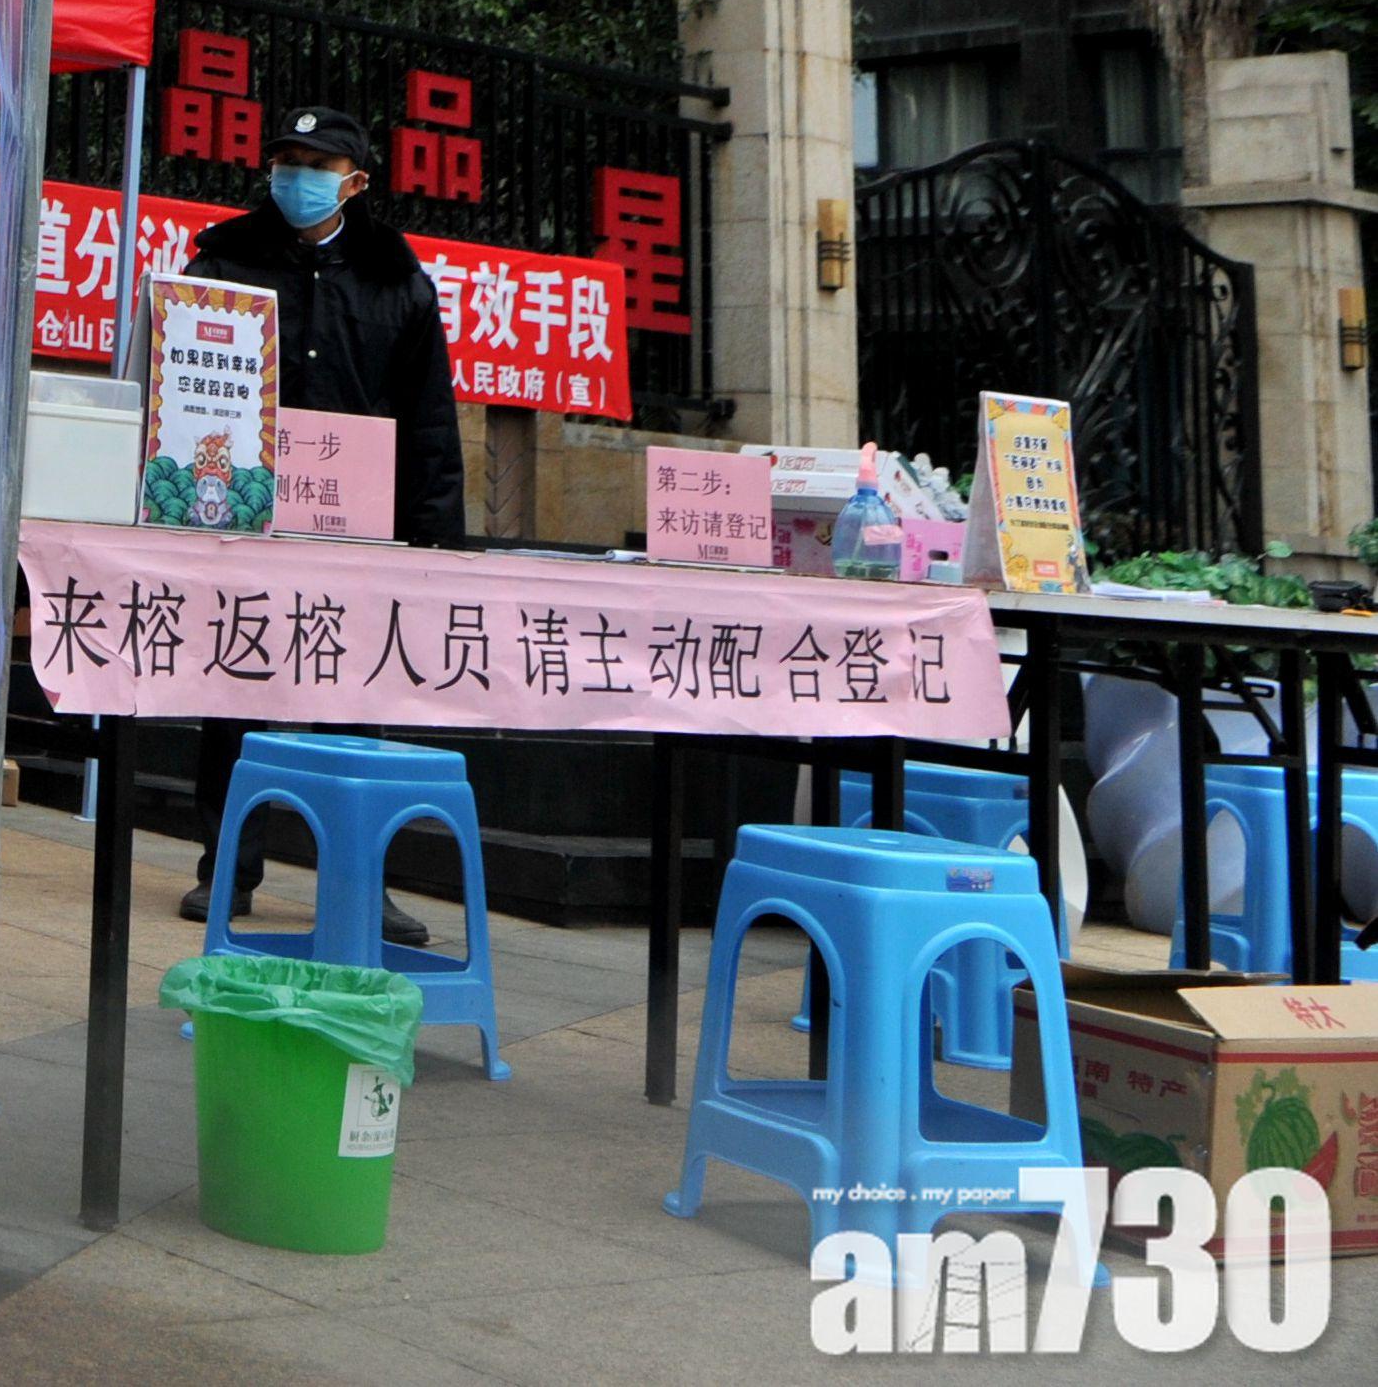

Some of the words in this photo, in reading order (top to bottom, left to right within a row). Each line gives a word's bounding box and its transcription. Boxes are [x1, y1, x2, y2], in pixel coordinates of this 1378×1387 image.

[421, 253, 613, 362] 有效手段
[656, 506, 768, 541] 来访请登记
[41, 576, 952, 706] 来榕返榕人员请主动配合登记
